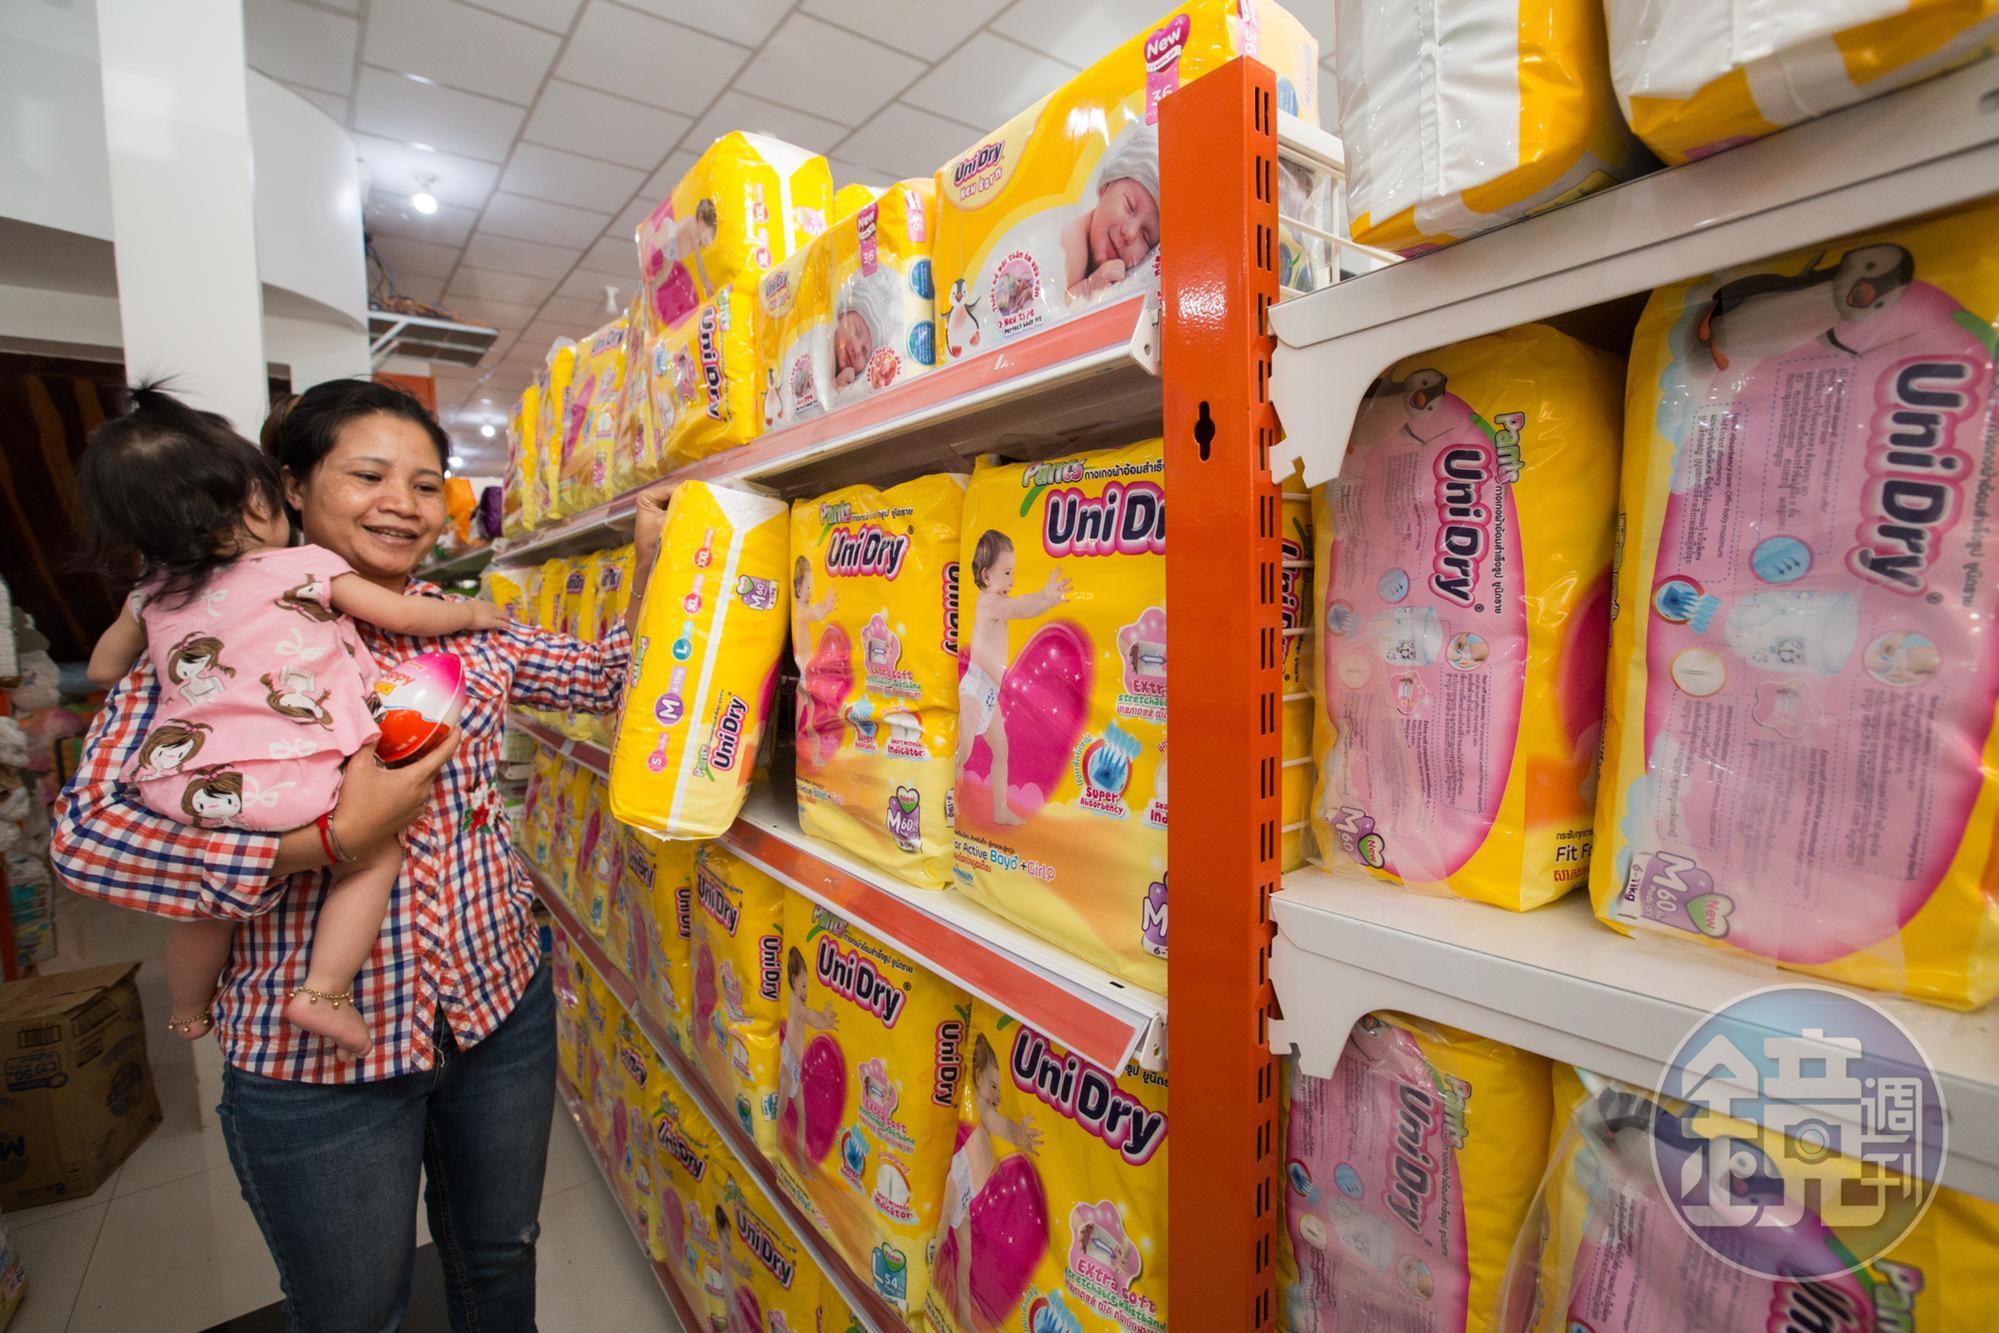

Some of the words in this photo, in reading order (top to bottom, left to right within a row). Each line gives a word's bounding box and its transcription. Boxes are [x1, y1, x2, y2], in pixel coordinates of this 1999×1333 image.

[1146, 27, 1182, 59] New
[954, 140, 1005, 187] UniDry
[701, 307, 722, 420] UniDry
[1495, 411, 1525, 486] Pants
[1021, 459, 1087, 487] Pants
[1863, 360, 1970, 597] UniDry
[1431, 447, 1489, 606] UniDry
[826, 526, 908, 580] UniDry
[748, 594, 766, 611] M
[676, 647, 689, 656] L
[658, 697, 681, 720] M
[712, 694, 748, 770] UniDry
[651, 757, 662, 767] S
[1079, 798, 1124, 816] Absorbency
[1085, 786, 1119, 803] Super
[886, 810, 901, 832] M
[901, 818, 913, 831] 60
[1334, 806, 1366, 834] M
[962, 842, 989, 861] Active
[1341, 832, 1354, 852] 60
[1556, 844, 1578, 862] Fit
[1651, 850, 1697, 893] M
[698, 874, 740, 935] UniDry
[1655, 887, 1679, 913] 60
[762, 936, 781, 1000] UniDry
[818, 939, 904, 1025] UniDry
[934, 1021, 961, 1106] UniDry
[1012, 1029, 1165, 1158] UniDry
[1386, 1084, 1433, 1234] UniDry
[734, 1205, 794, 1288] UniDry
[883, 1273, 898, 1288] 54
[1117, 1298, 1168, 1331] waistband
[1121, 1286, 1158, 1315] soft
